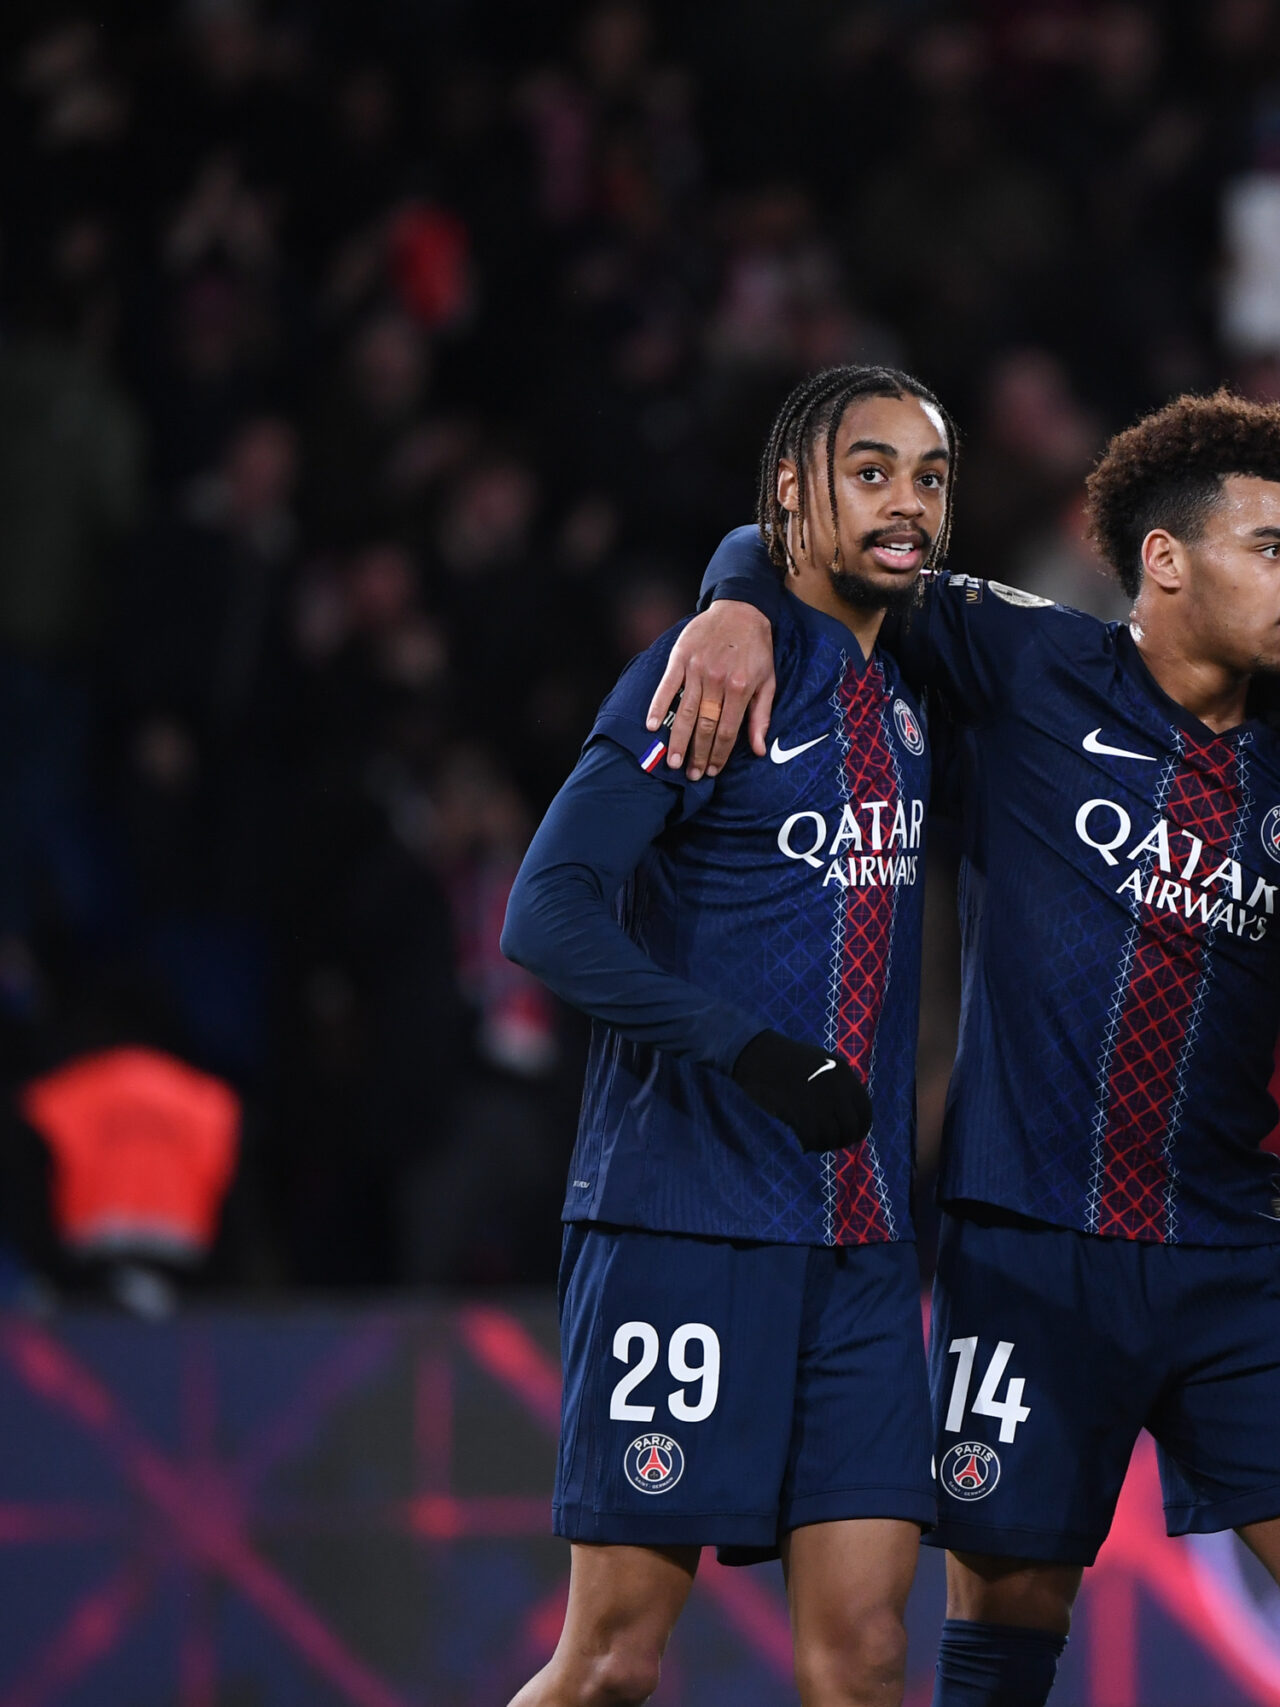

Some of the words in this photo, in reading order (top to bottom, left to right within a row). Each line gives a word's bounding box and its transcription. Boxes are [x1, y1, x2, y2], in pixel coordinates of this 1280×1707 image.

[777, 799, 924, 869] QATAR
[822, 855, 918, 887] AIRWAYS
[1116, 868, 1267, 942] AIRWAYS
[610, 1321, 720, 1422] 29
[944, 1335, 1031, 1444] 14
[634, 1436, 674, 1451] PARIS
[954, 1444, 994, 1462] PARIS
